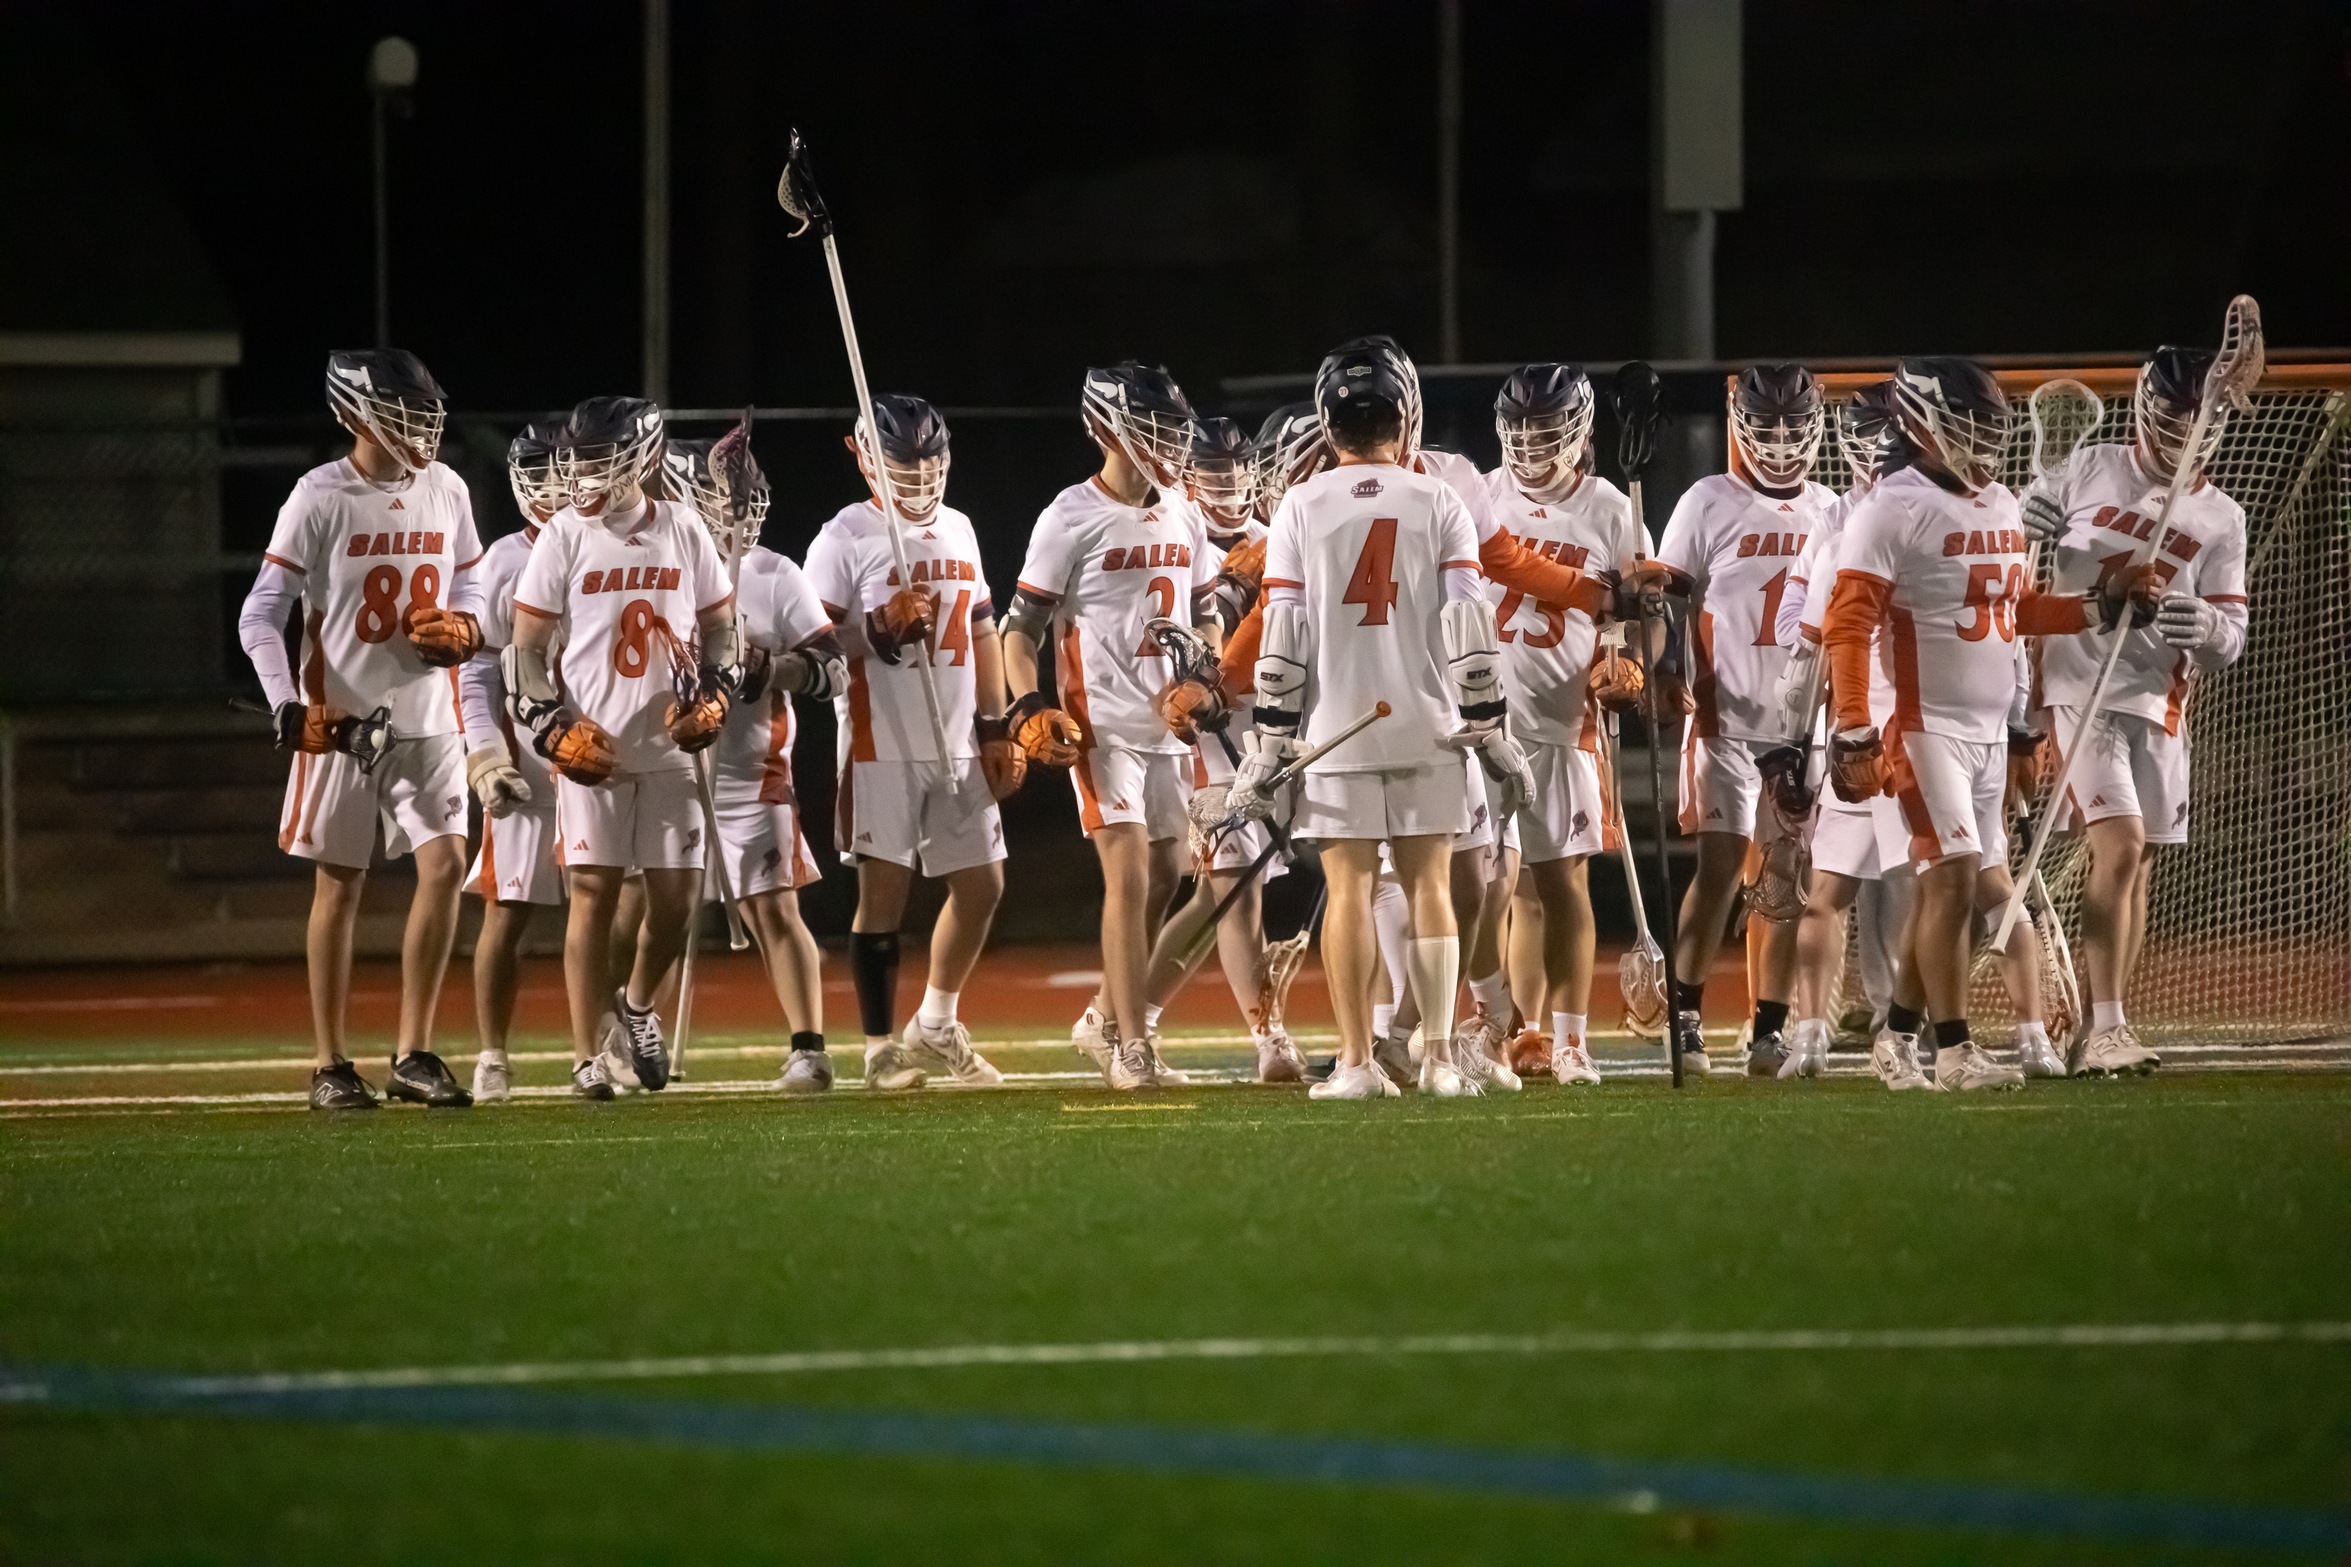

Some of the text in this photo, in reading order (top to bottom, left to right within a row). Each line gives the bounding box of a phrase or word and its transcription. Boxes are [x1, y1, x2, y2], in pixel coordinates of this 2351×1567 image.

[346, 531, 444, 557] SALEM
[1737, 532, 1808, 558] SAL
[1942, 529, 2026, 557] SALEM
[2092, 506, 2202, 563] SALEM
[1101, 543, 1191, 571] SALEM
[581, 566, 682, 595] SALEM
[887, 559, 976, 586] SALEM
[1341, 518, 1399, 626] 4
[355, 563, 440, 643] 88
[1134, 576, 1175, 657] 2
[614, 598, 655, 678] 8
[1260, 671, 1285, 682] STX
[1466, 666, 1492, 680] STX
